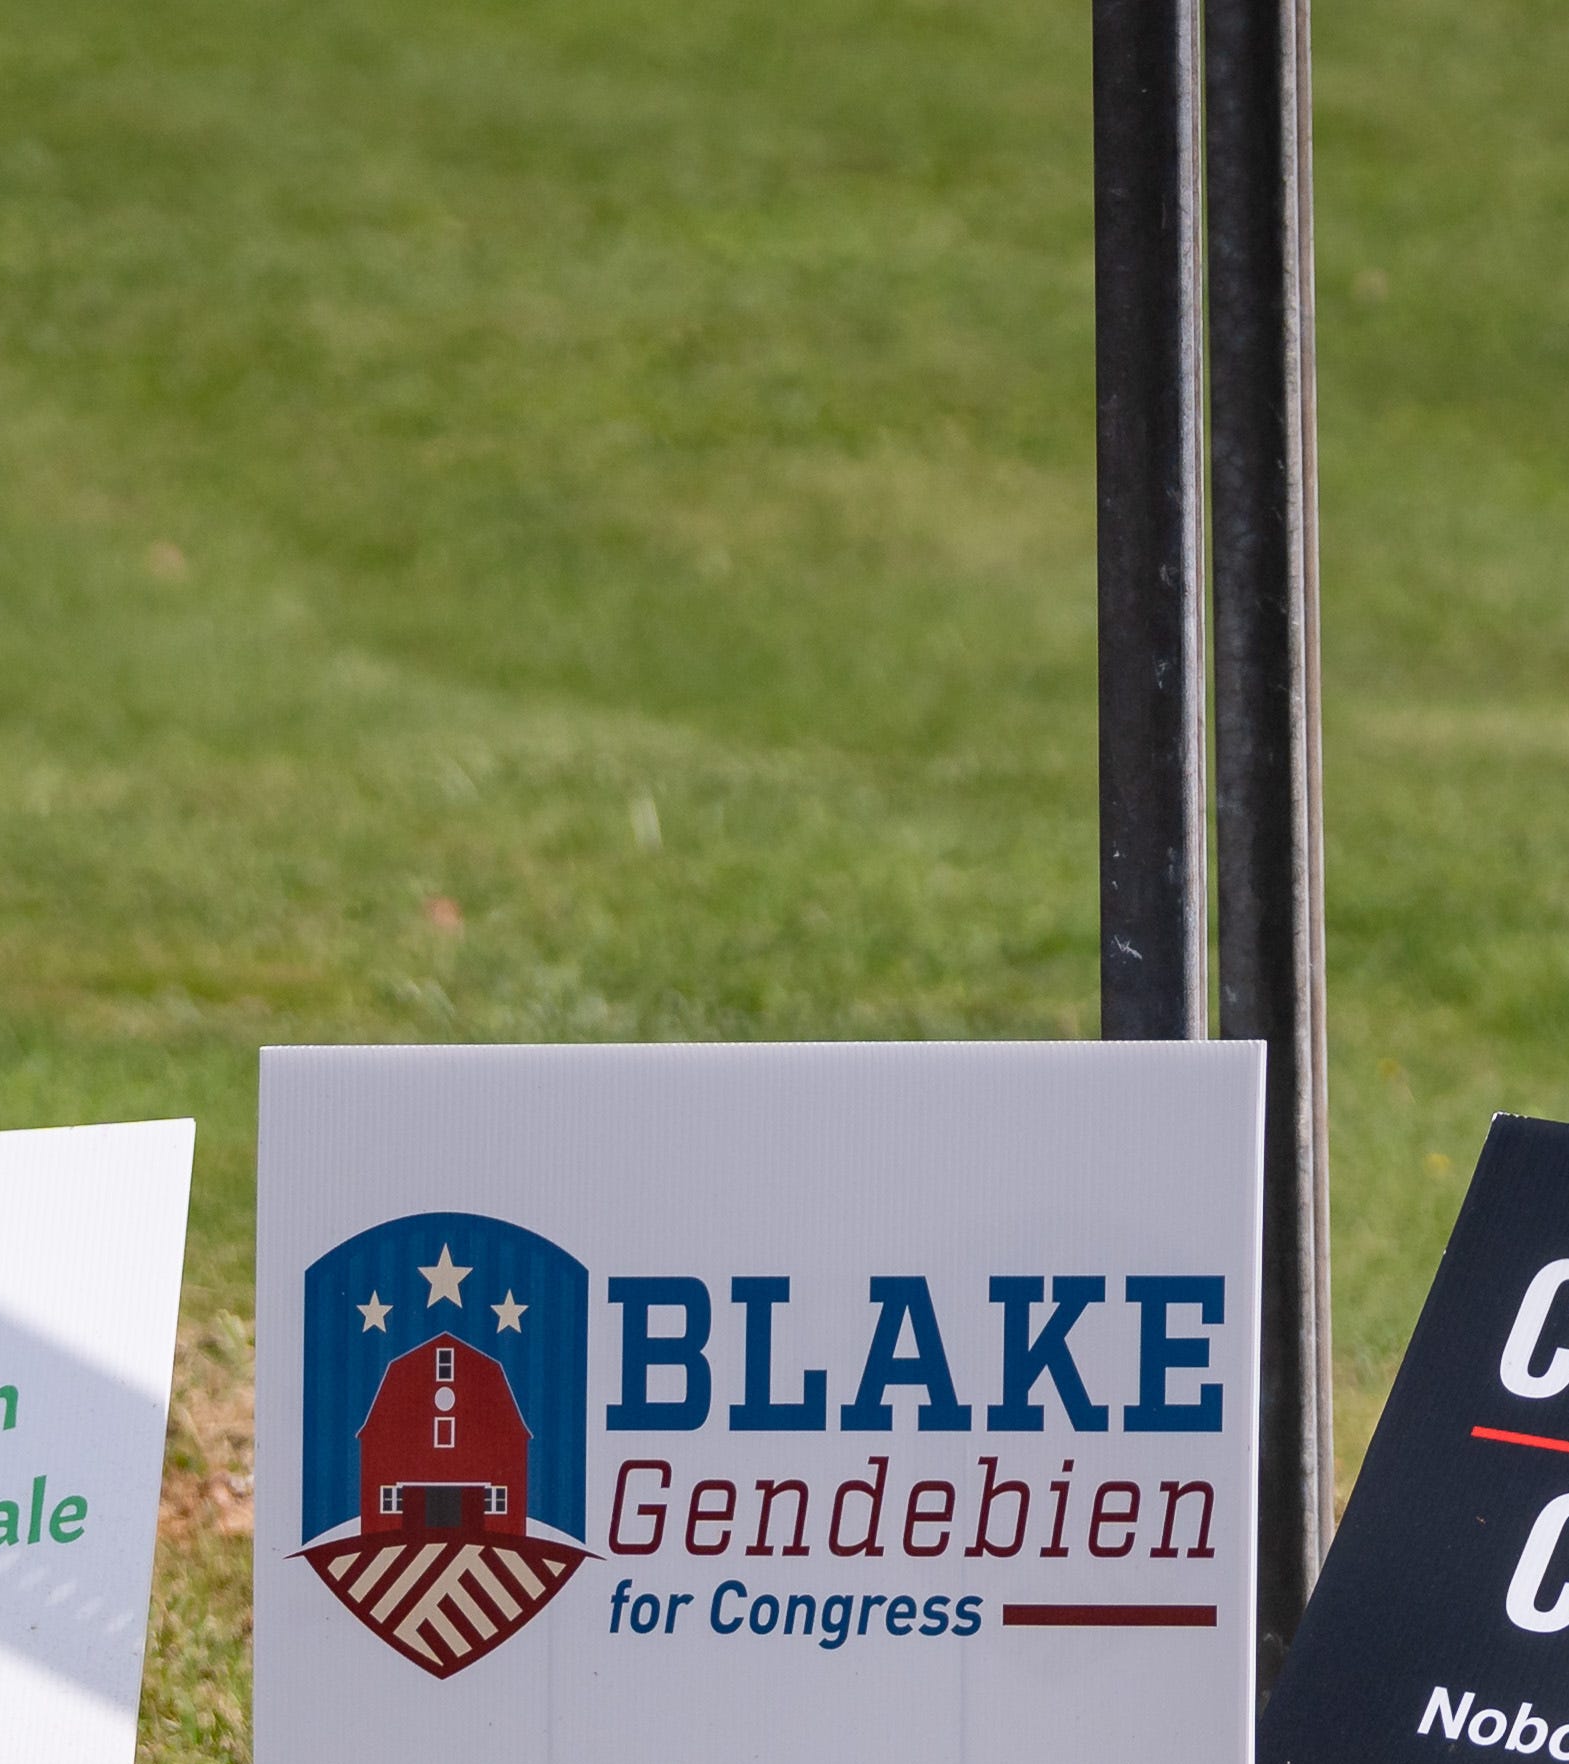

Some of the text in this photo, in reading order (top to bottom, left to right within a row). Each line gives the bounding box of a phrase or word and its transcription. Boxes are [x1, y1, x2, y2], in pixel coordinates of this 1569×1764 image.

[605, 1274, 1226, 1433] BLAKE
[607, 1455, 1217, 1560] Gendebien
[609, 1577, 984, 1651] for Congress
